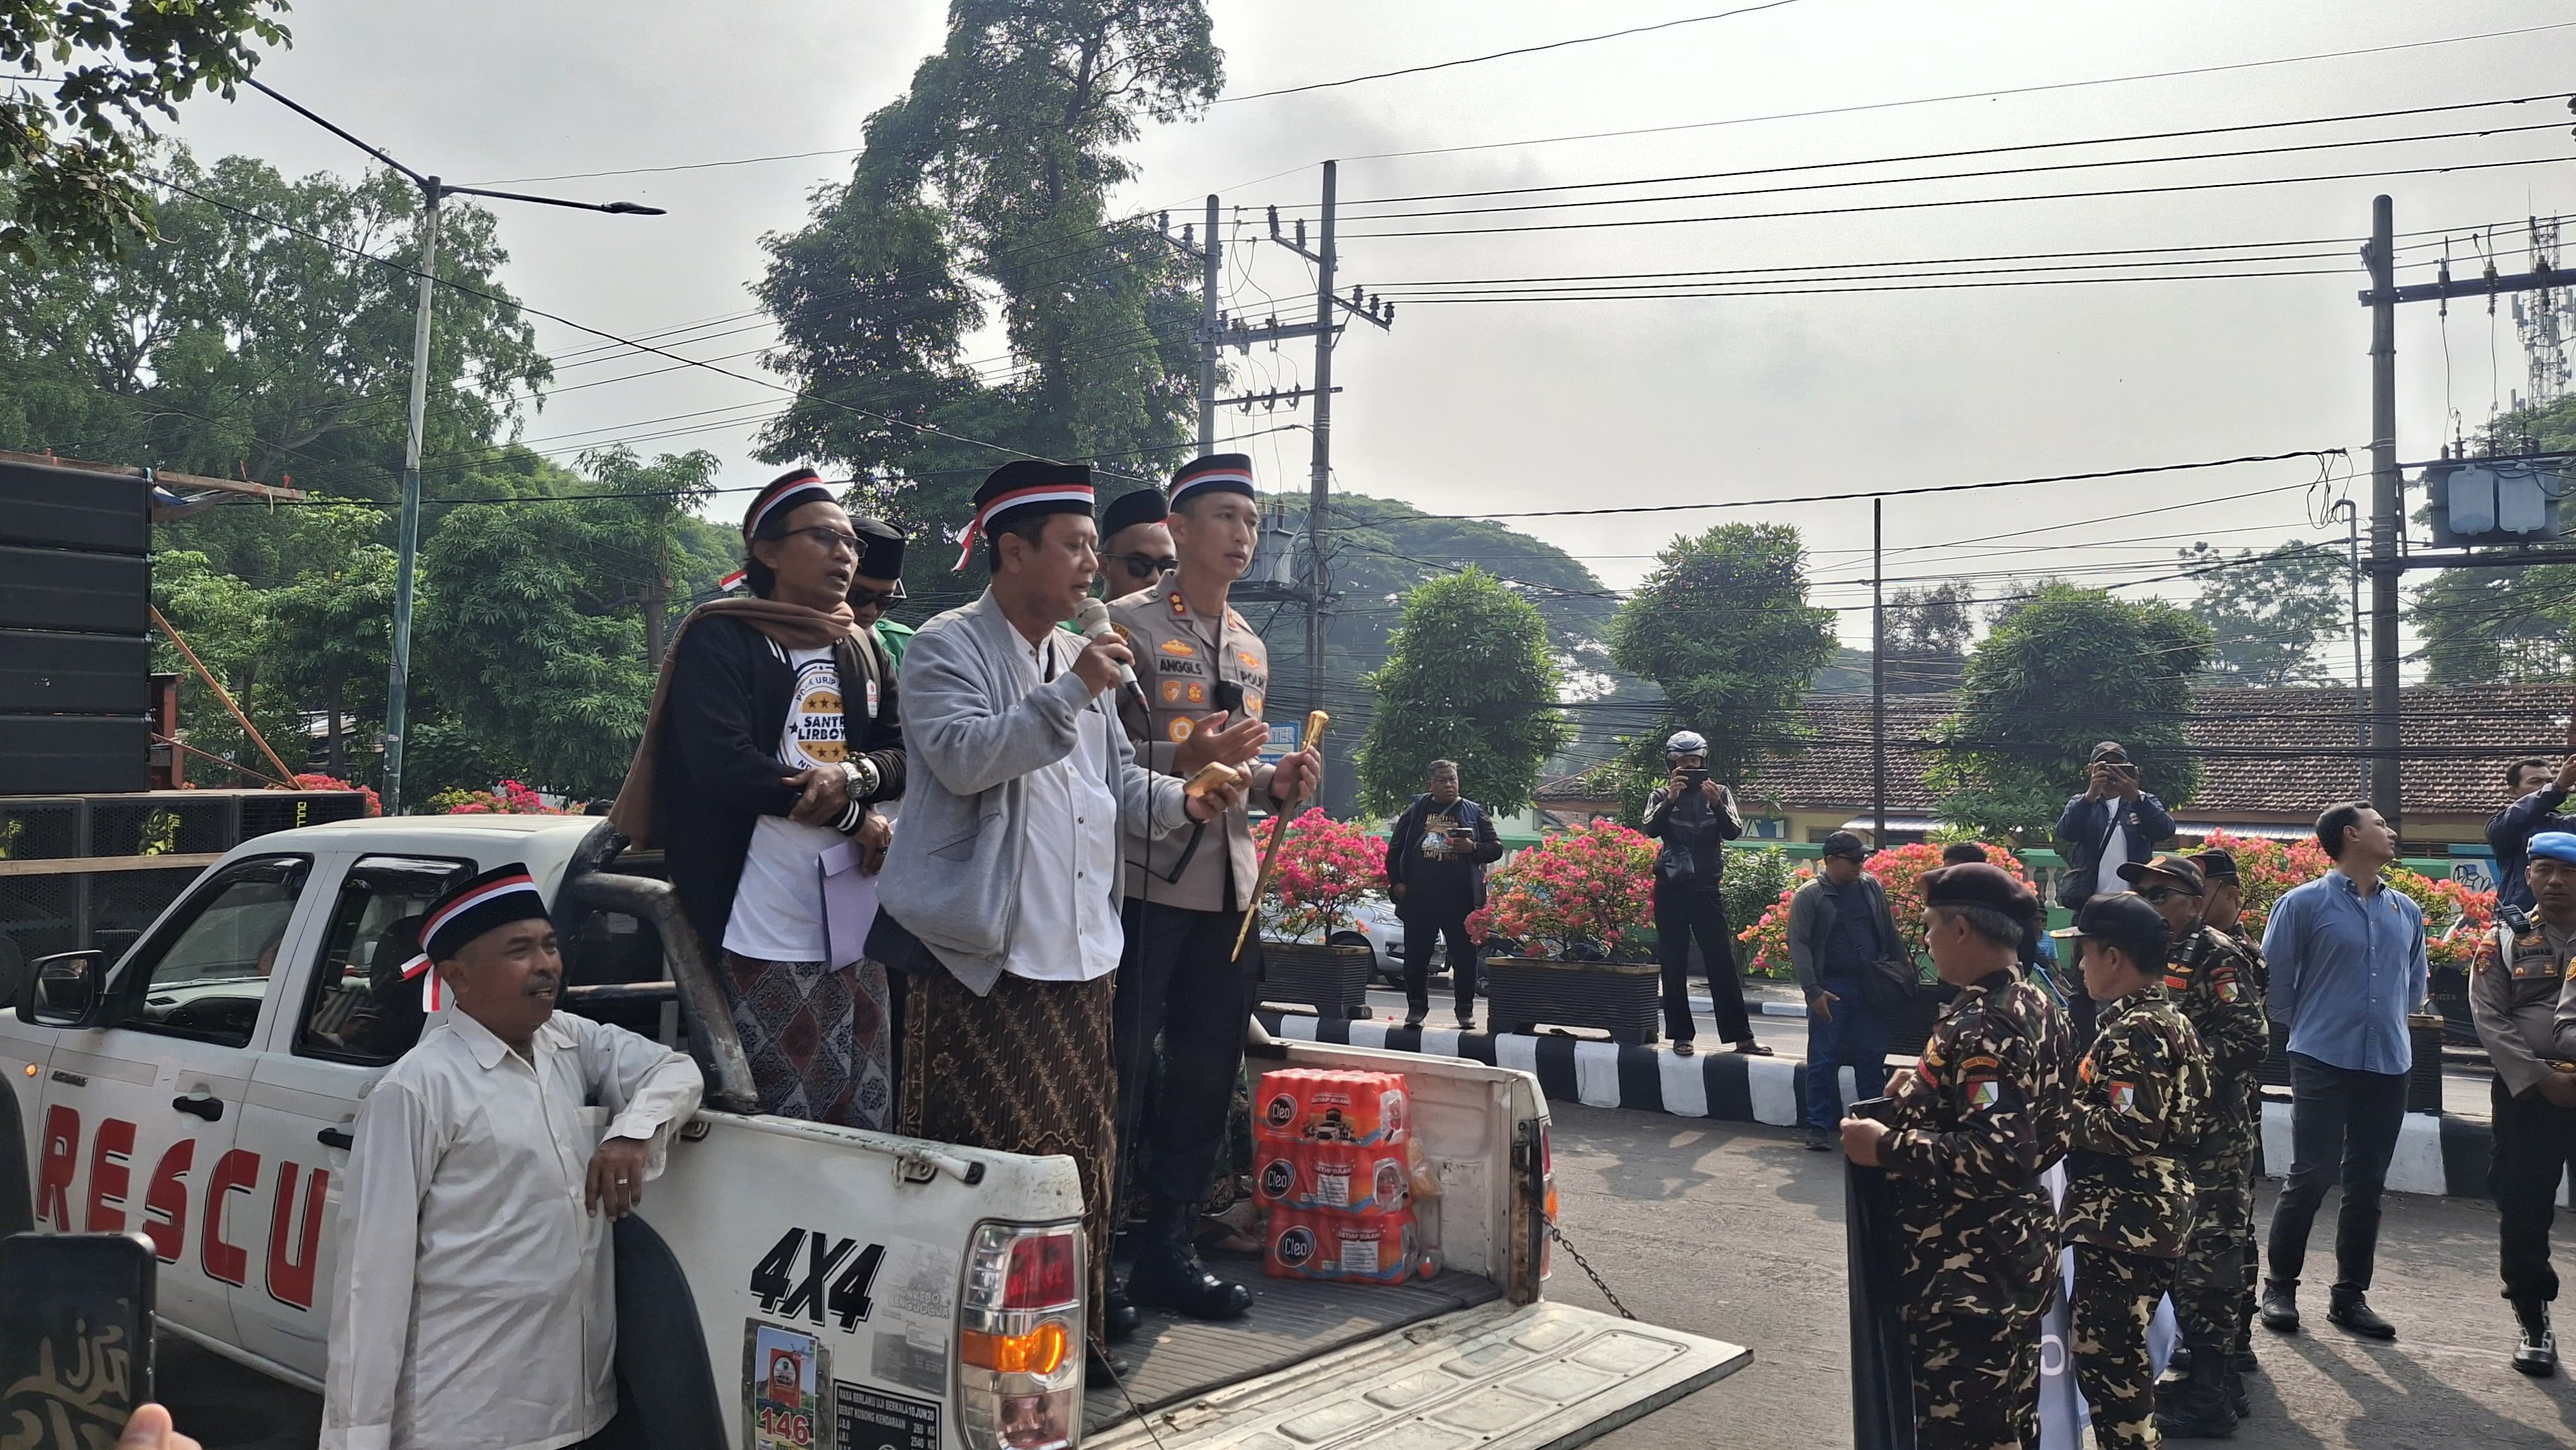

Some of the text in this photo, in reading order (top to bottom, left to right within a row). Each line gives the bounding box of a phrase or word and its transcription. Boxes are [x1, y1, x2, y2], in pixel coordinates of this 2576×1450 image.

[804, 716, 845, 728] SANTR
[797, 728, 847, 740] LIRBOY
[1272, 1104, 1290, 1119] Cleo
[1268, 1170, 1287, 1187] Cleo
[36, 1104, 329, 1312] RESCU
[1285, 1238, 1307, 1256] Cleo
[749, 1227, 886, 1334] 4X4
[838, 1405, 854, 1416] BERAT
[885, 1400, 908, 1414] BERKALA
[909, 1406, 915, 1417] 10
[915, 1408, 927, 1419] JUN
[927, 1410, 934, 1421] 20
[760, 1406, 809, 1446] 146
[927, 1425, 935, 1436] KG
[927, 1440, 935, 1450] KG
